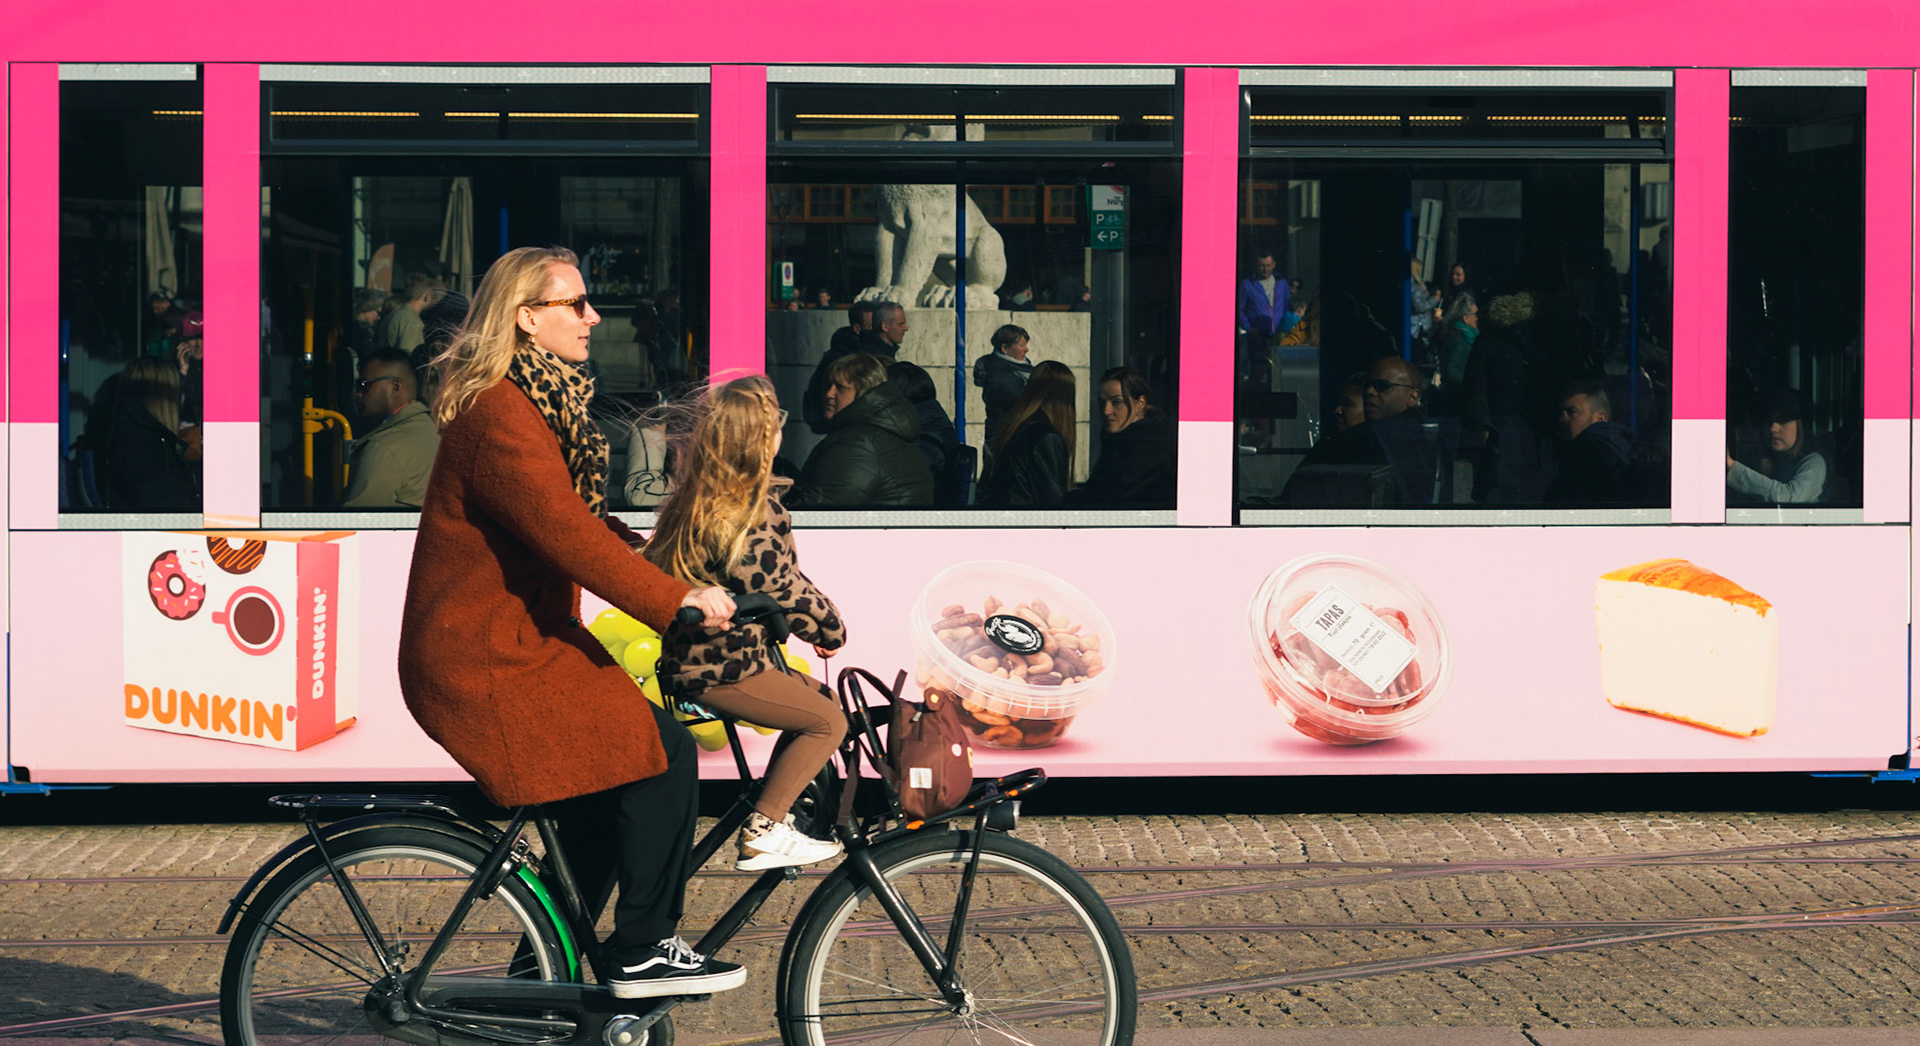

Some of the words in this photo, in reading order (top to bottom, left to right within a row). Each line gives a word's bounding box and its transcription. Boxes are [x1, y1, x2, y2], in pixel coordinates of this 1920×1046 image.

[1096, 213, 1105, 225] P
[1109, 231, 1119, 242] P
[1315, 604, 1344, 631] TAPAS
[312, 587, 327, 700] DUNKIN'
[124, 683, 297, 742] DUNKIN'
